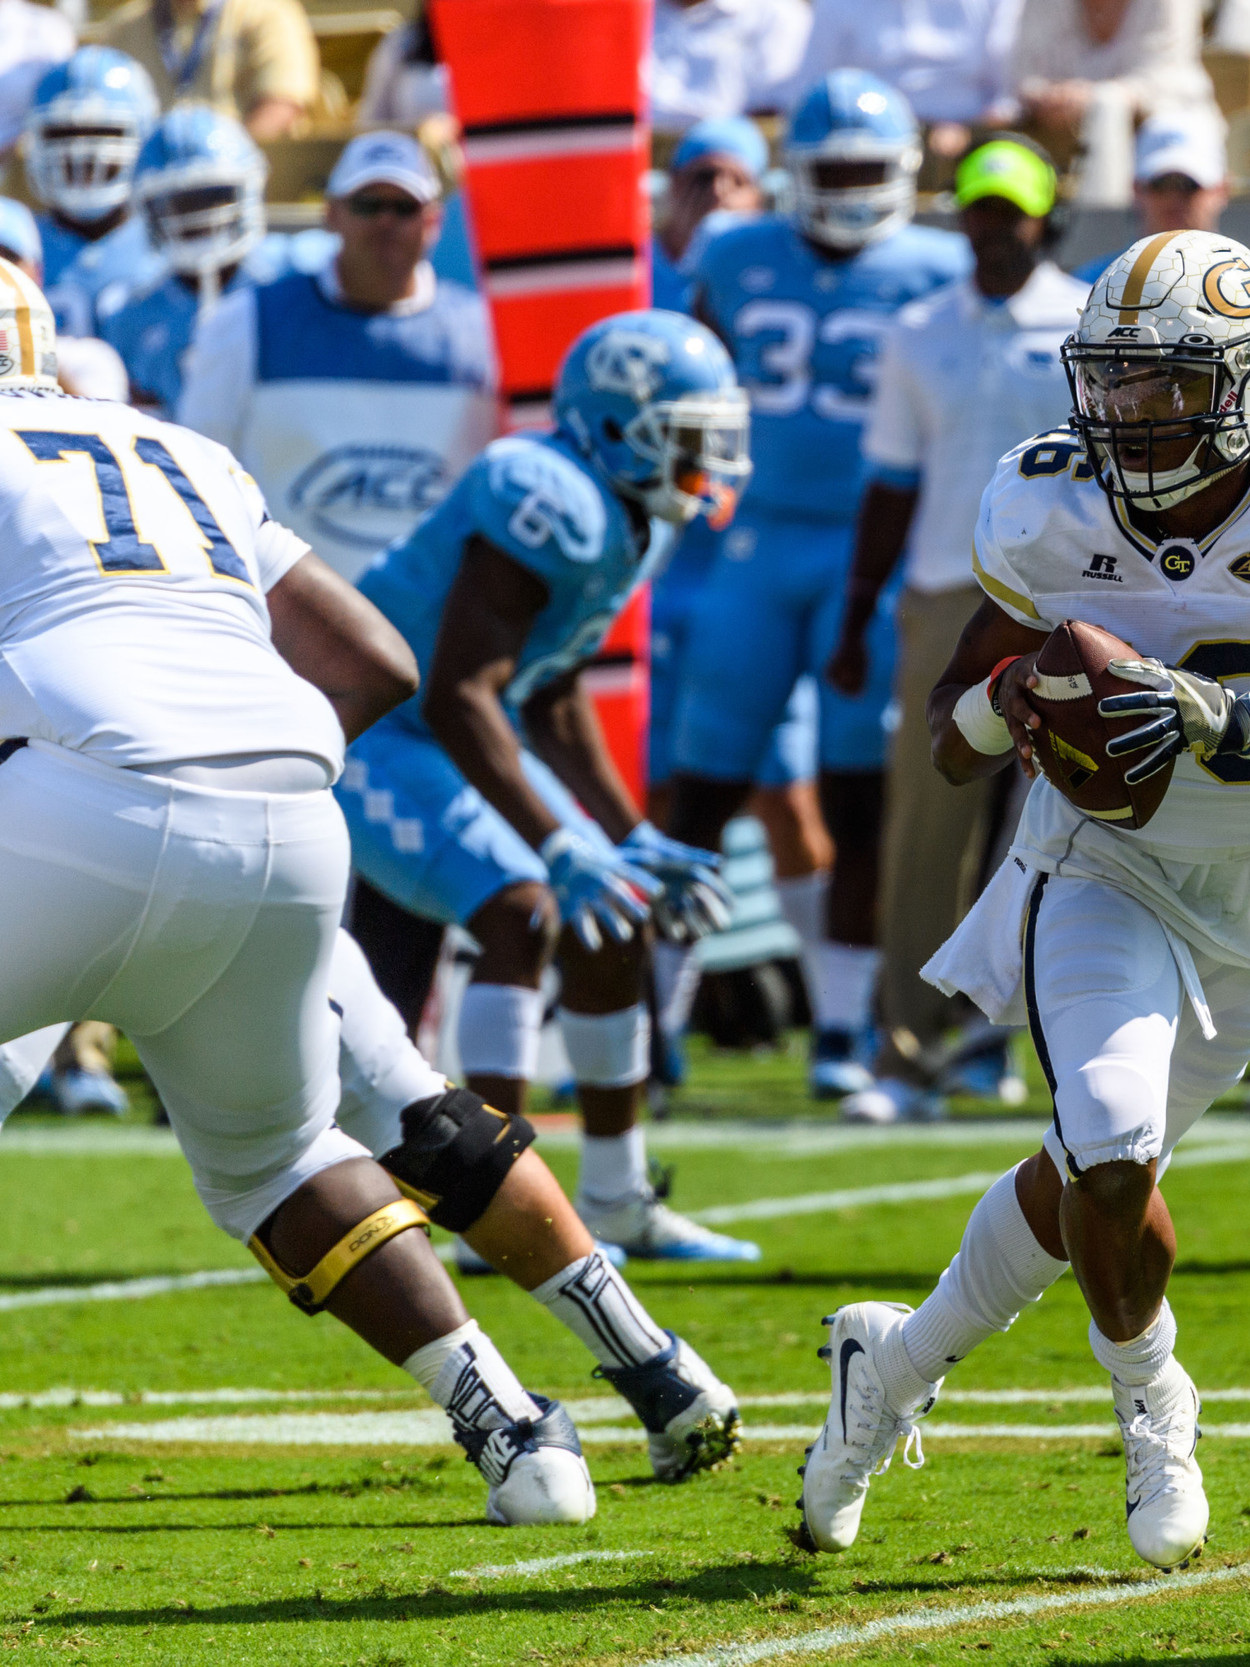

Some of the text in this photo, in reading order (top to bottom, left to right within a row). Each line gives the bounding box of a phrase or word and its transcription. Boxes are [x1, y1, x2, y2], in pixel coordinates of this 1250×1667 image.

[1107, 327, 1141, 338] ACC
[316, 468, 446, 511] ACC
[9, 428, 259, 593] 71
[1165, 555, 1190, 573] GT
[1082, 570, 1124, 583] RUSSELL
